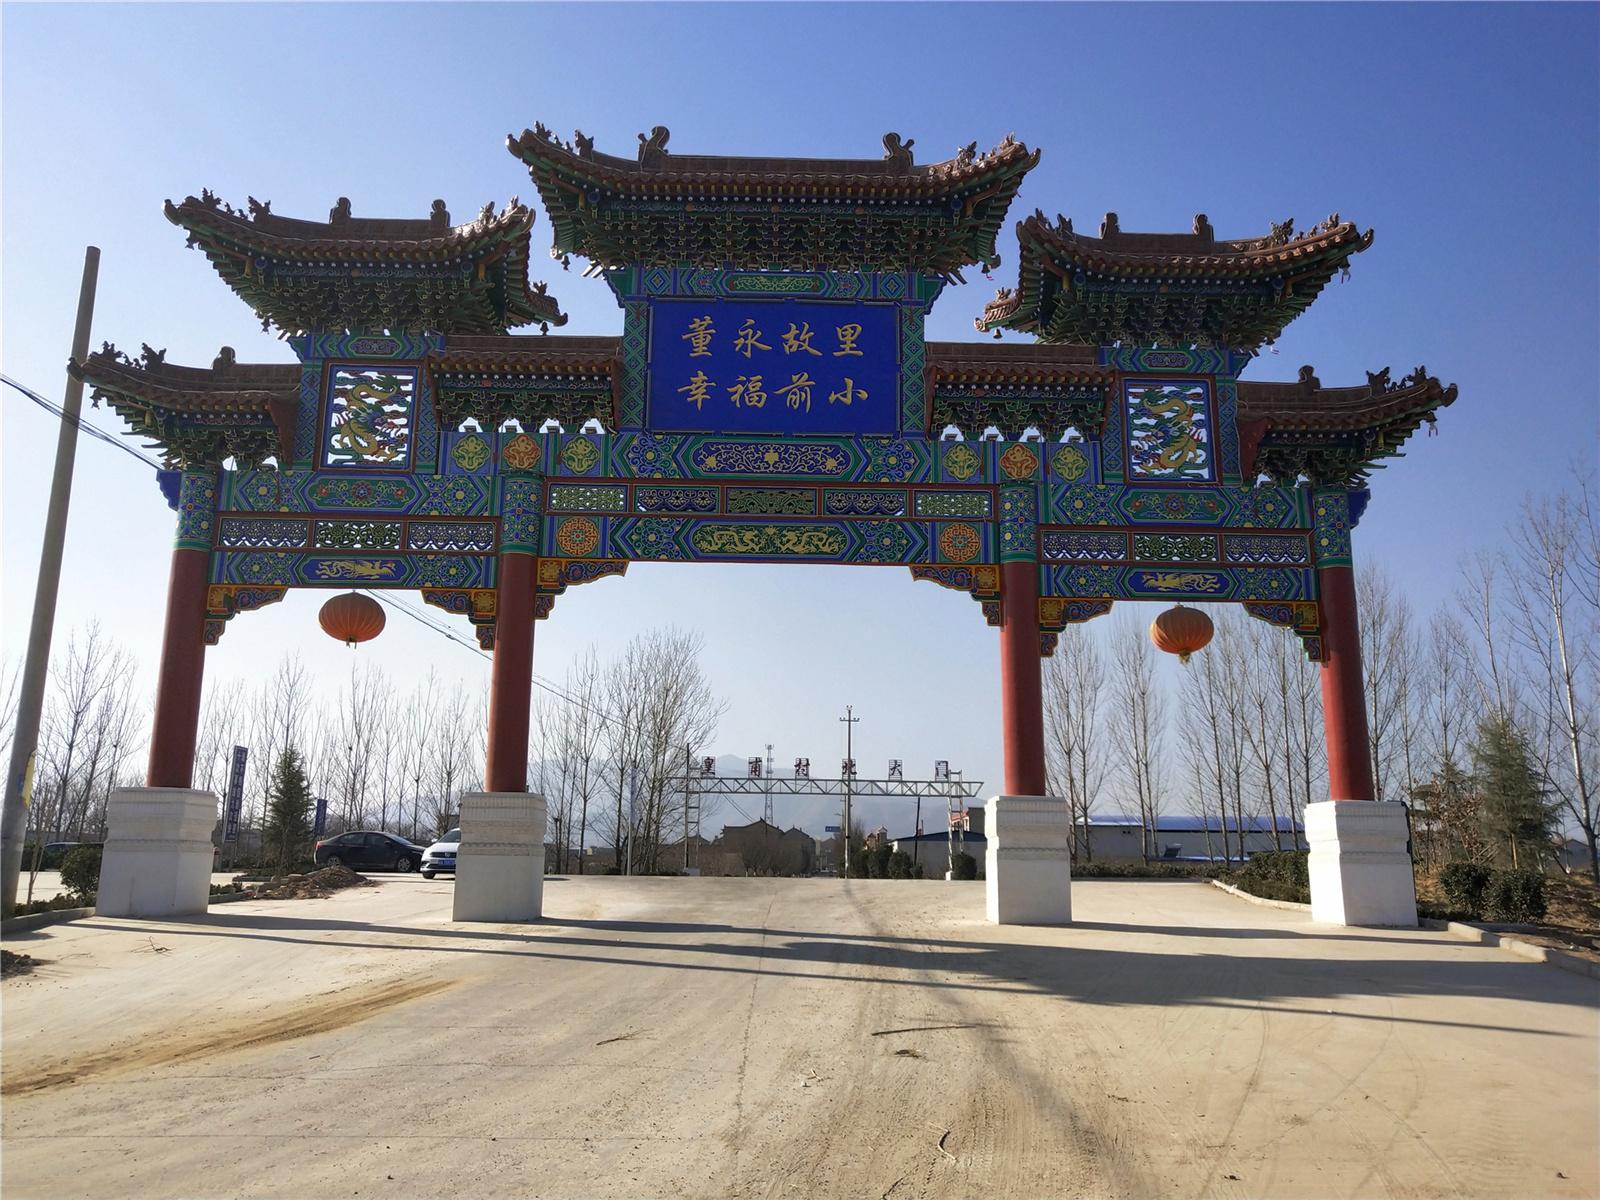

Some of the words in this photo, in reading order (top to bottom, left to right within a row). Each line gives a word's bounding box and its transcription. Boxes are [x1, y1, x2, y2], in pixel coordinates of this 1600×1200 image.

[681, 315, 865, 358] 董永故里
[677, 370, 869, 414] 幸福前小
[701, 756, 949, 779] 皇甫村北大门
